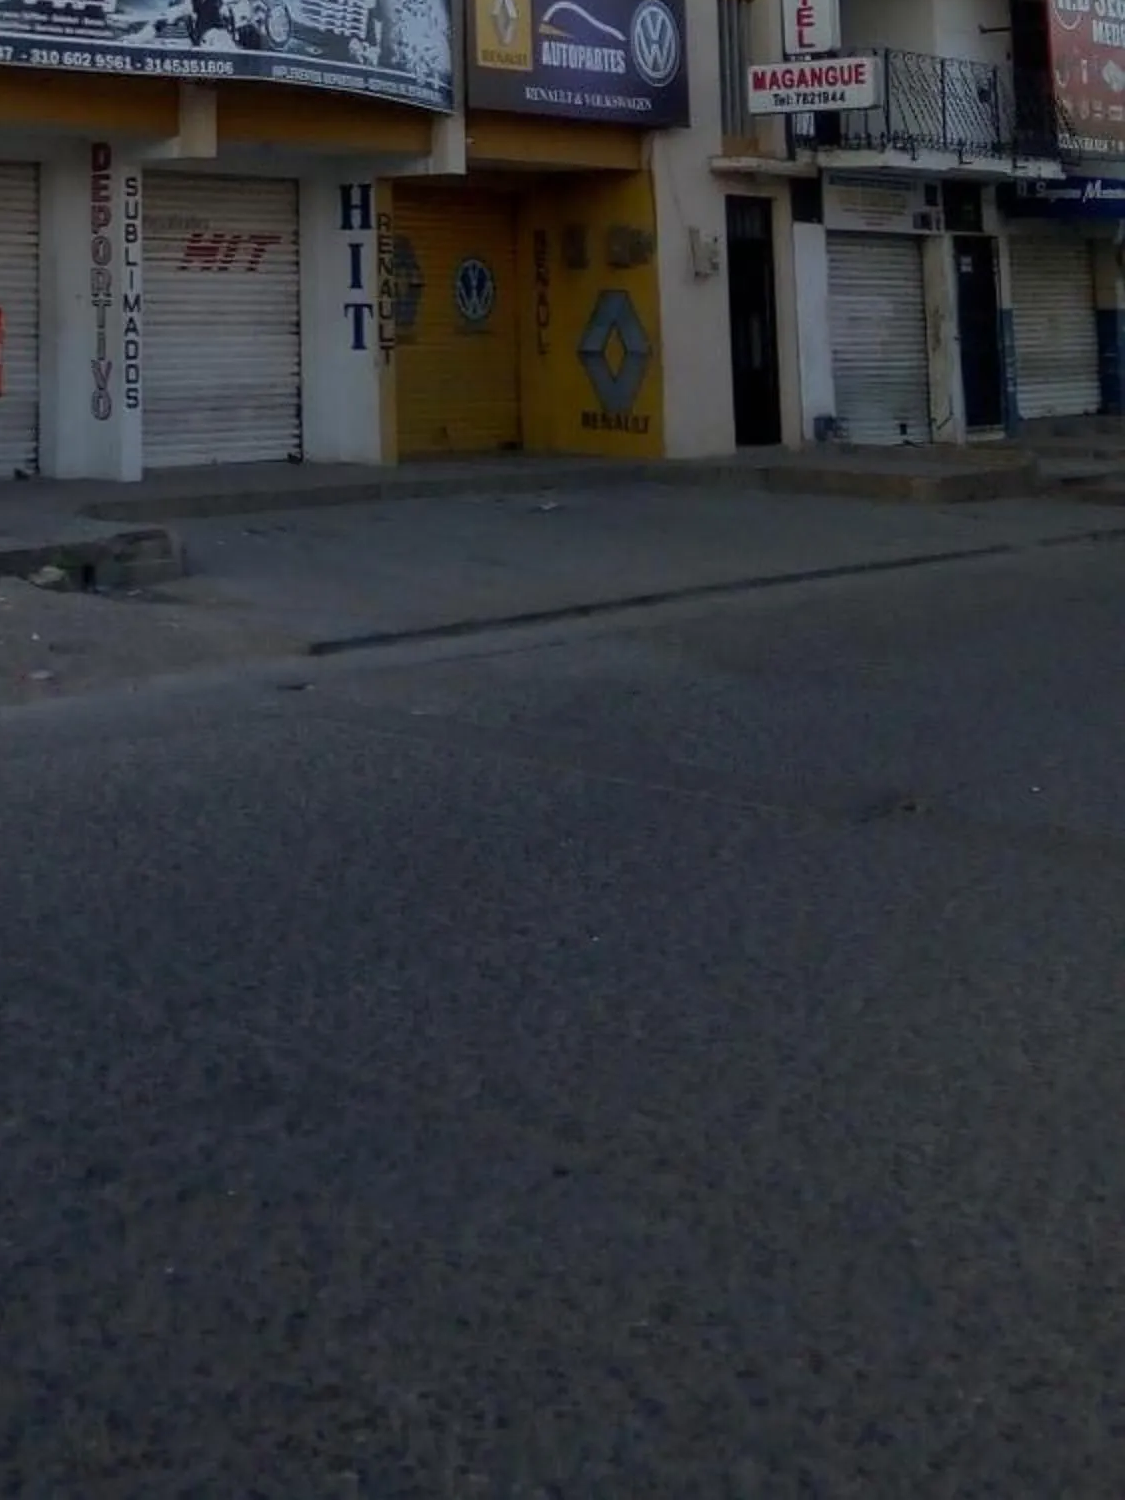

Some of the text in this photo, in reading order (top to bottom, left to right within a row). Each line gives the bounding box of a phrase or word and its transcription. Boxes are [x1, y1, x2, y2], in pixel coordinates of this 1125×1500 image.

[30, 47, 60, 66] 310
[63, 51, 92, 67] 602
[525, 85, 572, 105] RENAULT
[542, 40, 626, 75] AUTOPARTES
[752, 62, 868, 93] MAGANGUE
[90, 141, 113, 421] DEPORTIVO
[122, 176, 142, 411] SUBLIMADOS
[339, 182, 374, 351] HIT
[376, 212, 396, 366] RENAULT
